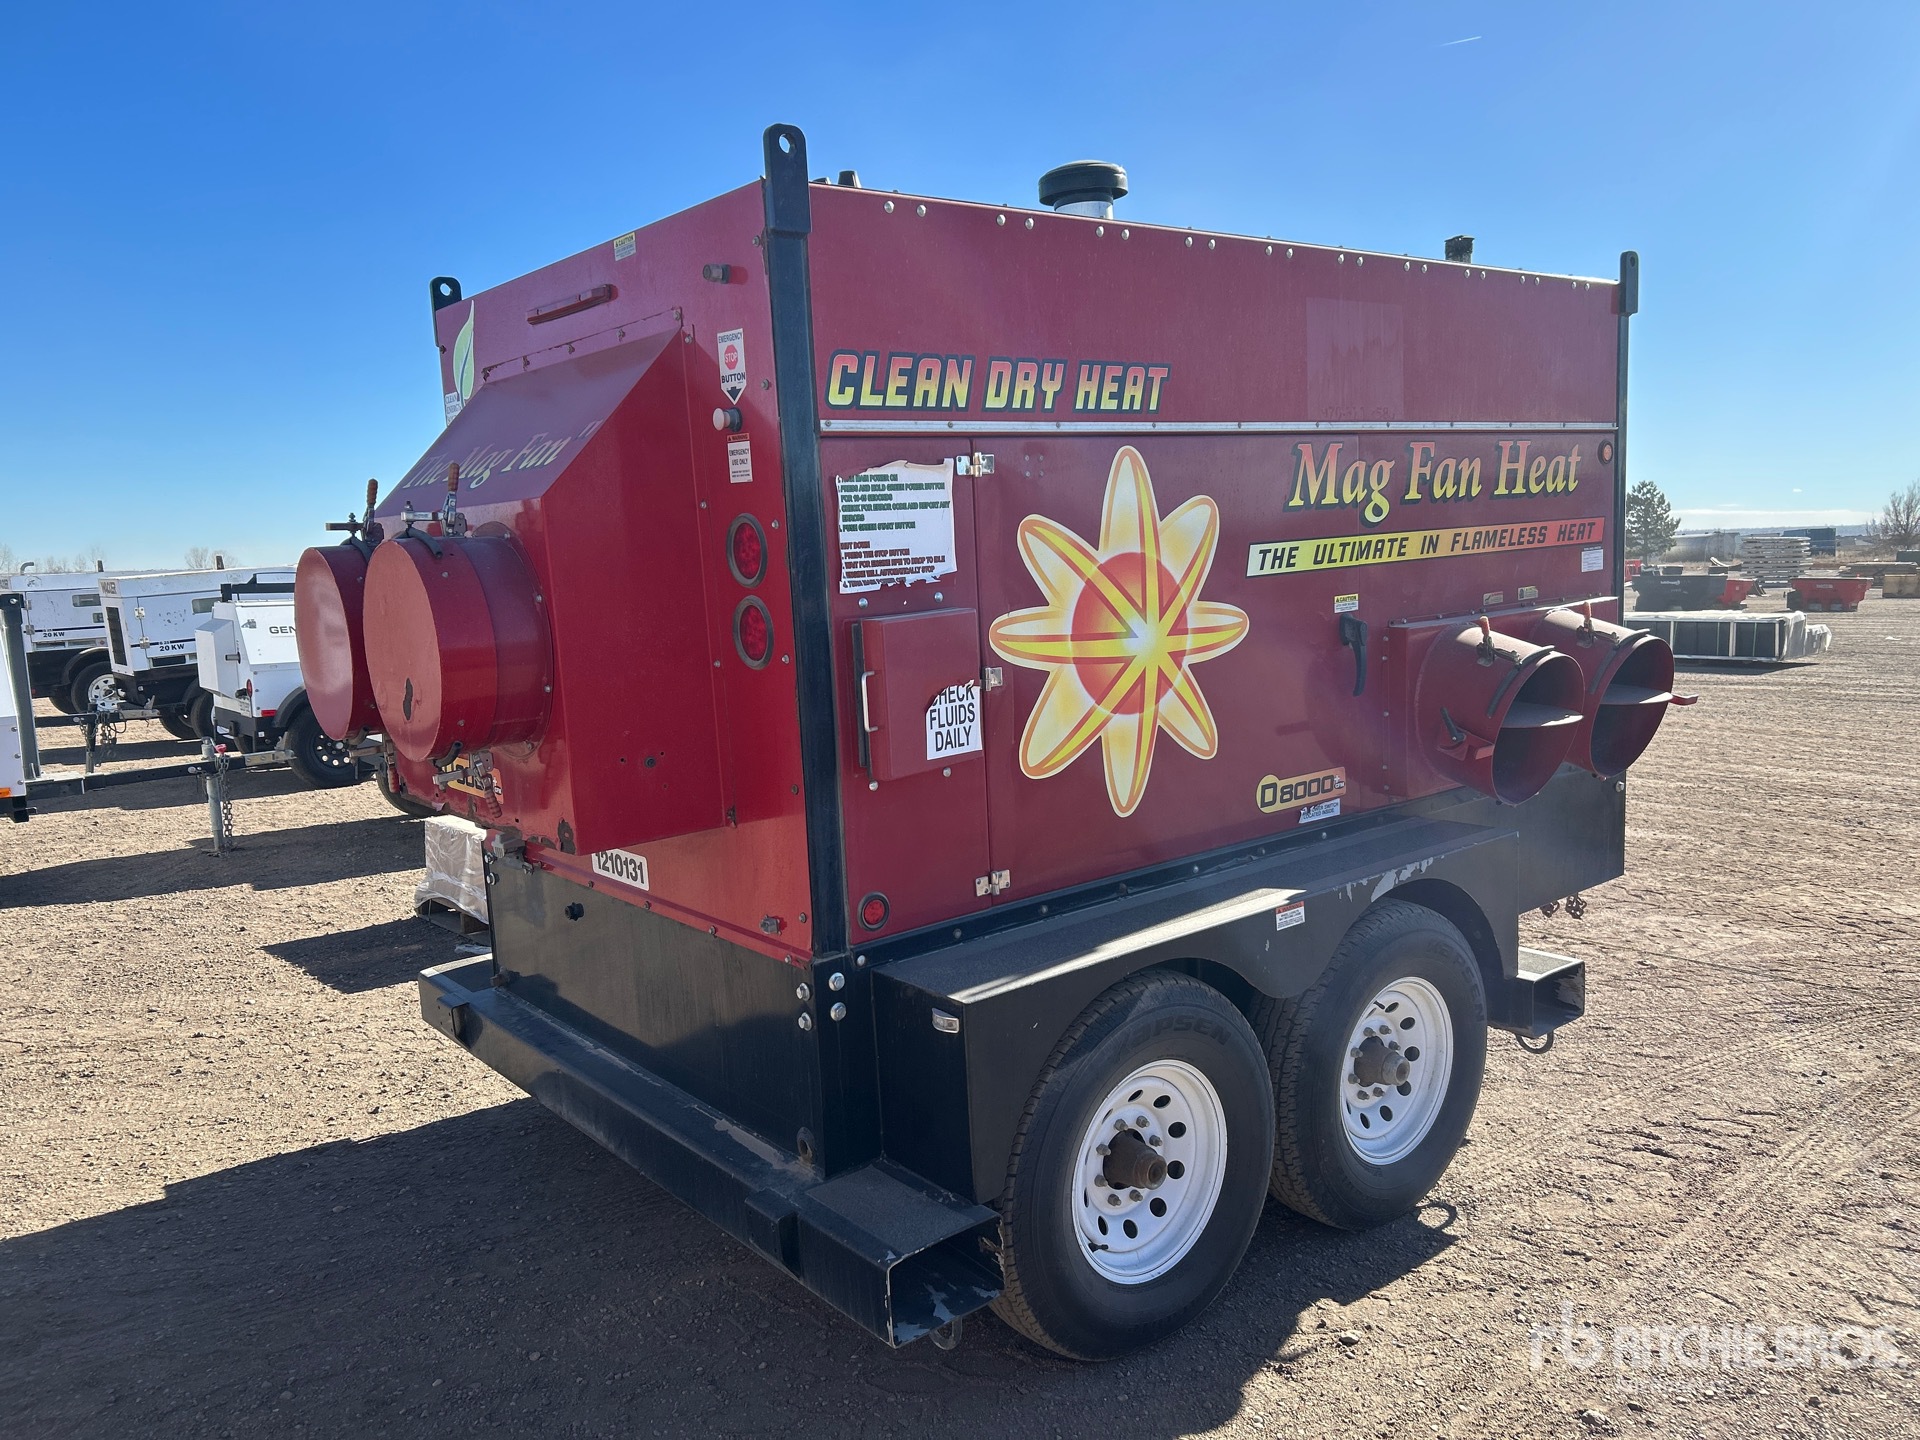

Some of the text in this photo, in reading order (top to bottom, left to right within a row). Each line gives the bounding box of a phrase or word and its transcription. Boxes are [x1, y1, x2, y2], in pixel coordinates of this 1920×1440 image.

[718, 331, 743, 344] EMERGENCY
[725, 351, 738, 363] STOP
[721, 371, 746, 384] BUTTON
[826, 352, 1169, 412] CLEAN DRY HEAT
[403, 452, 450, 489] The
[443, 442, 515, 490] Mag
[729, 448, 750, 457] EMERGENCY
[1286, 439, 1582, 525] Mag Fan Heat
[1258, 520, 1597, 571] THE ULTIMATE IN FLAMELESS HEAT
[171, 643, 185, 651] KW
[929, 702, 976, 730] FLUIDS
[935, 725, 972, 752] DAILY
[595, 850, 645, 885] 1210131
